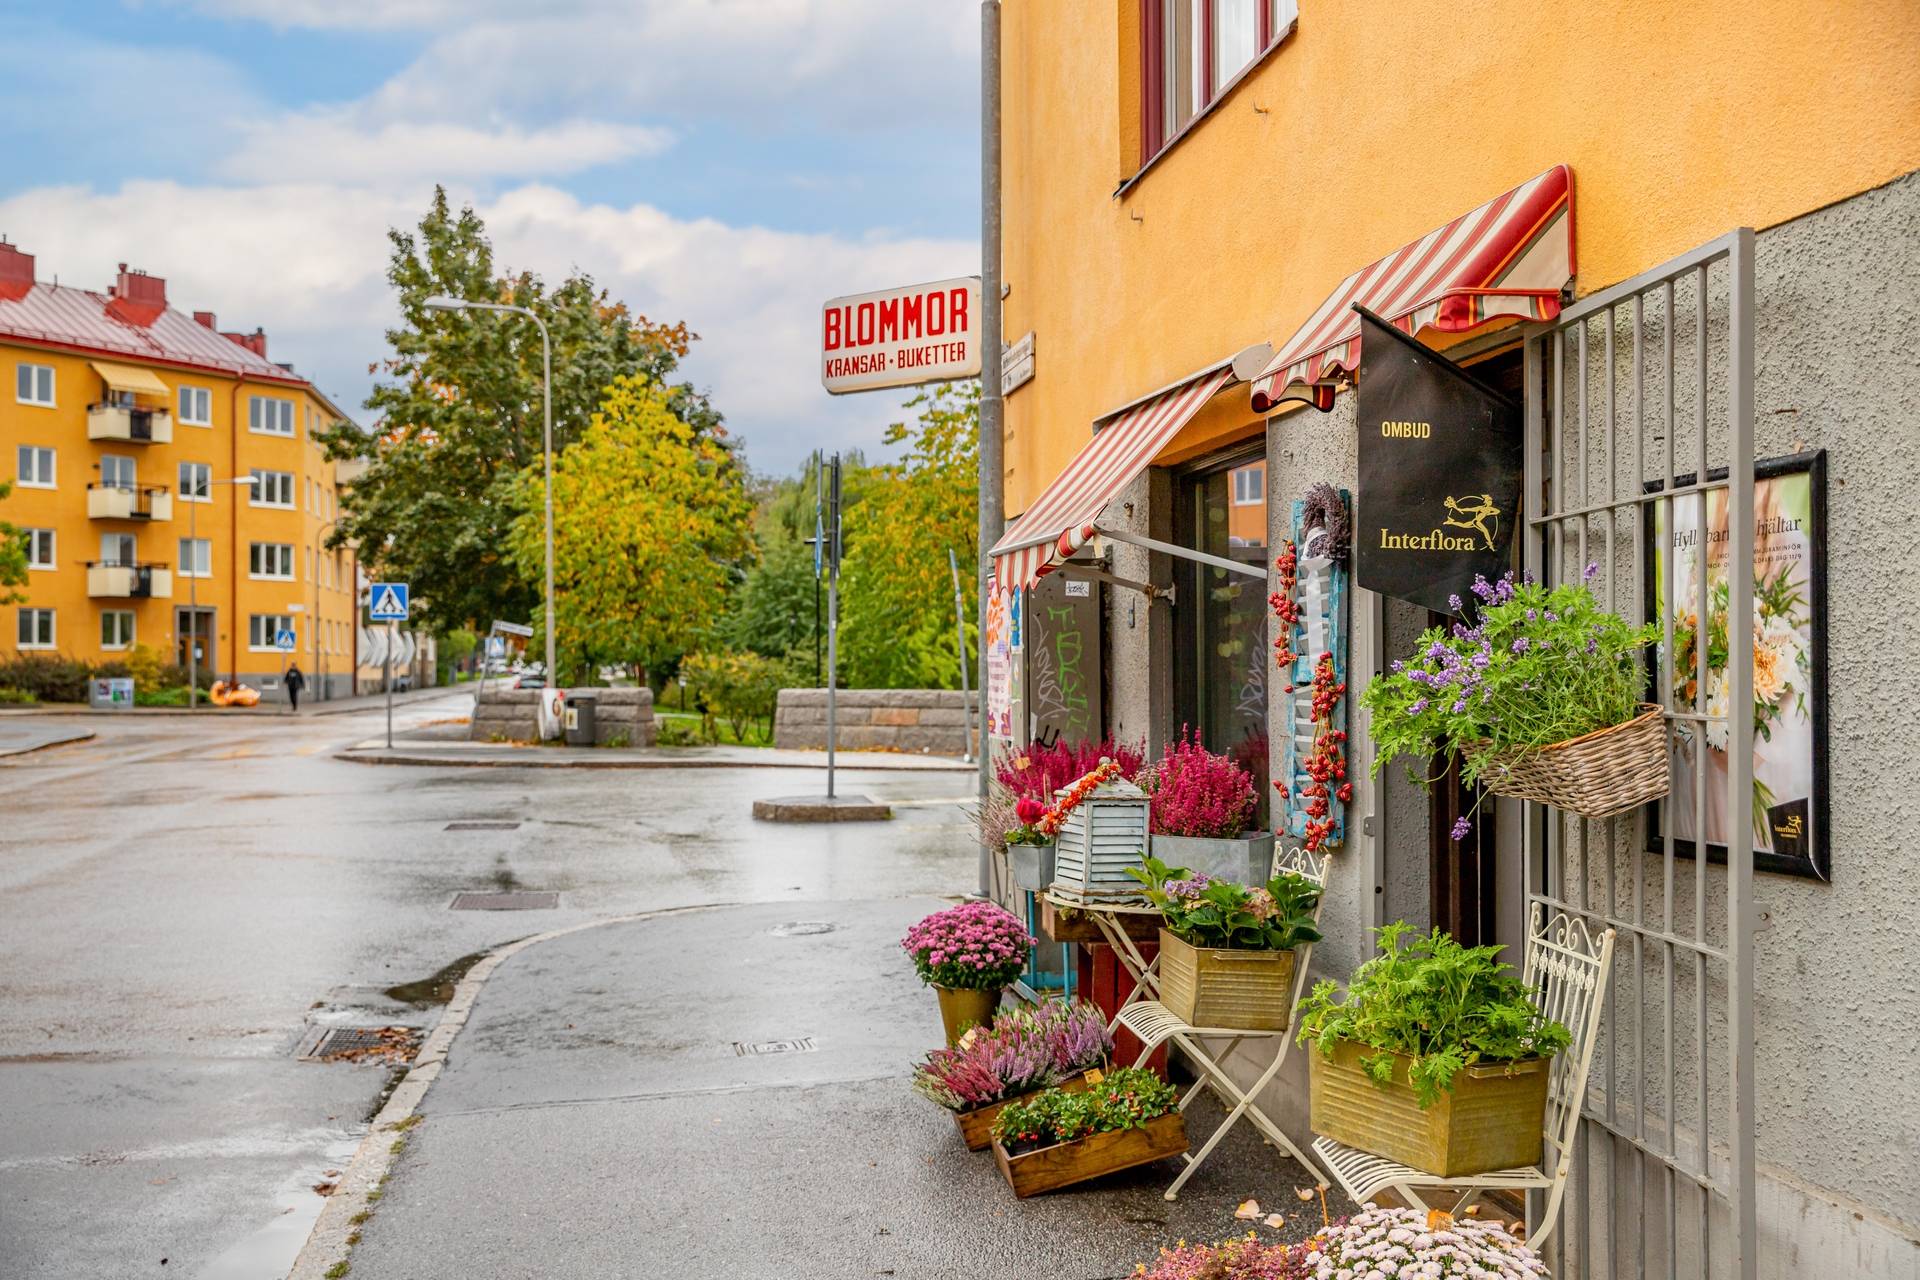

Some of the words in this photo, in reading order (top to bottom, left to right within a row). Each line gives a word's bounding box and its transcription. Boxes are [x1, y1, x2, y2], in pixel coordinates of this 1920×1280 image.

[824, 287, 968, 351] BLOMMOR
[826, 353, 885, 378] KRANSAR
[897, 341, 965, 369] BUKETTER
[1381, 421, 1431, 439] OMBUD
[1380, 528, 1475, 551] Interflora
[1673, 529, 1697, 552] Hyll
[1756, 516, 1802, 540] hjältar
